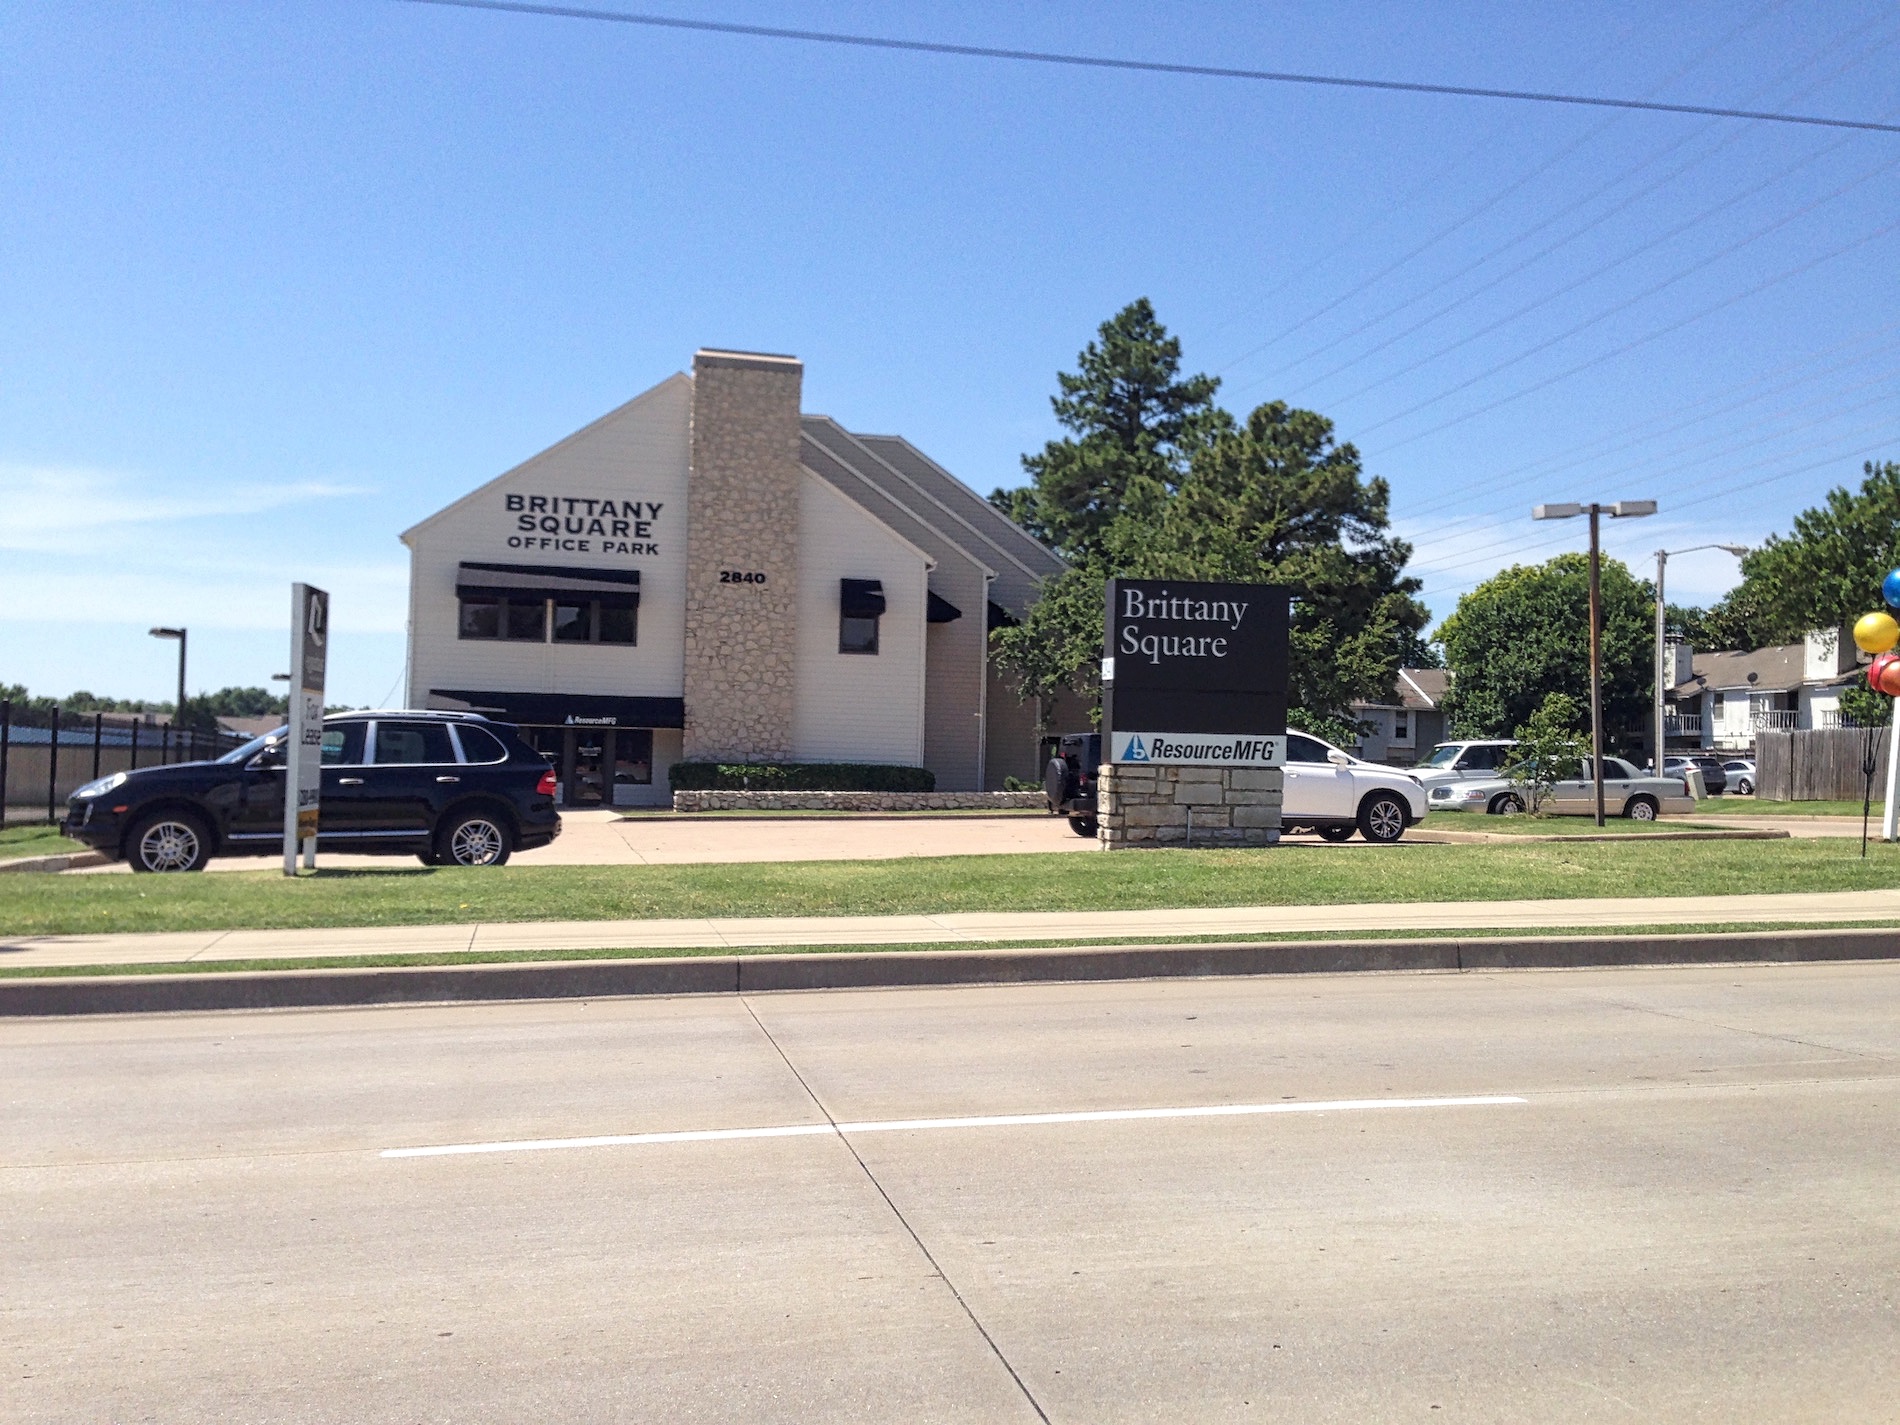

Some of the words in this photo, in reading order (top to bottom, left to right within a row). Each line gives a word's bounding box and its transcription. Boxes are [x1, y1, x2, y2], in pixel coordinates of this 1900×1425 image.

[505, 494, 664, 520] BRITTANY
[517, 514, 652, 538] SQUARE
[507, 536, 590, 552] OFFICE
[602, 541, 659, 555] PARK
[720, 571, 766, 584] 2840
[1122, 588, 1249, 631] Brittany
[1120, 625, 1228, 665] Square
[574, 715, 617, 725] ResourceMFG
[1151, 738, 1275, 761] ResourceMFG
